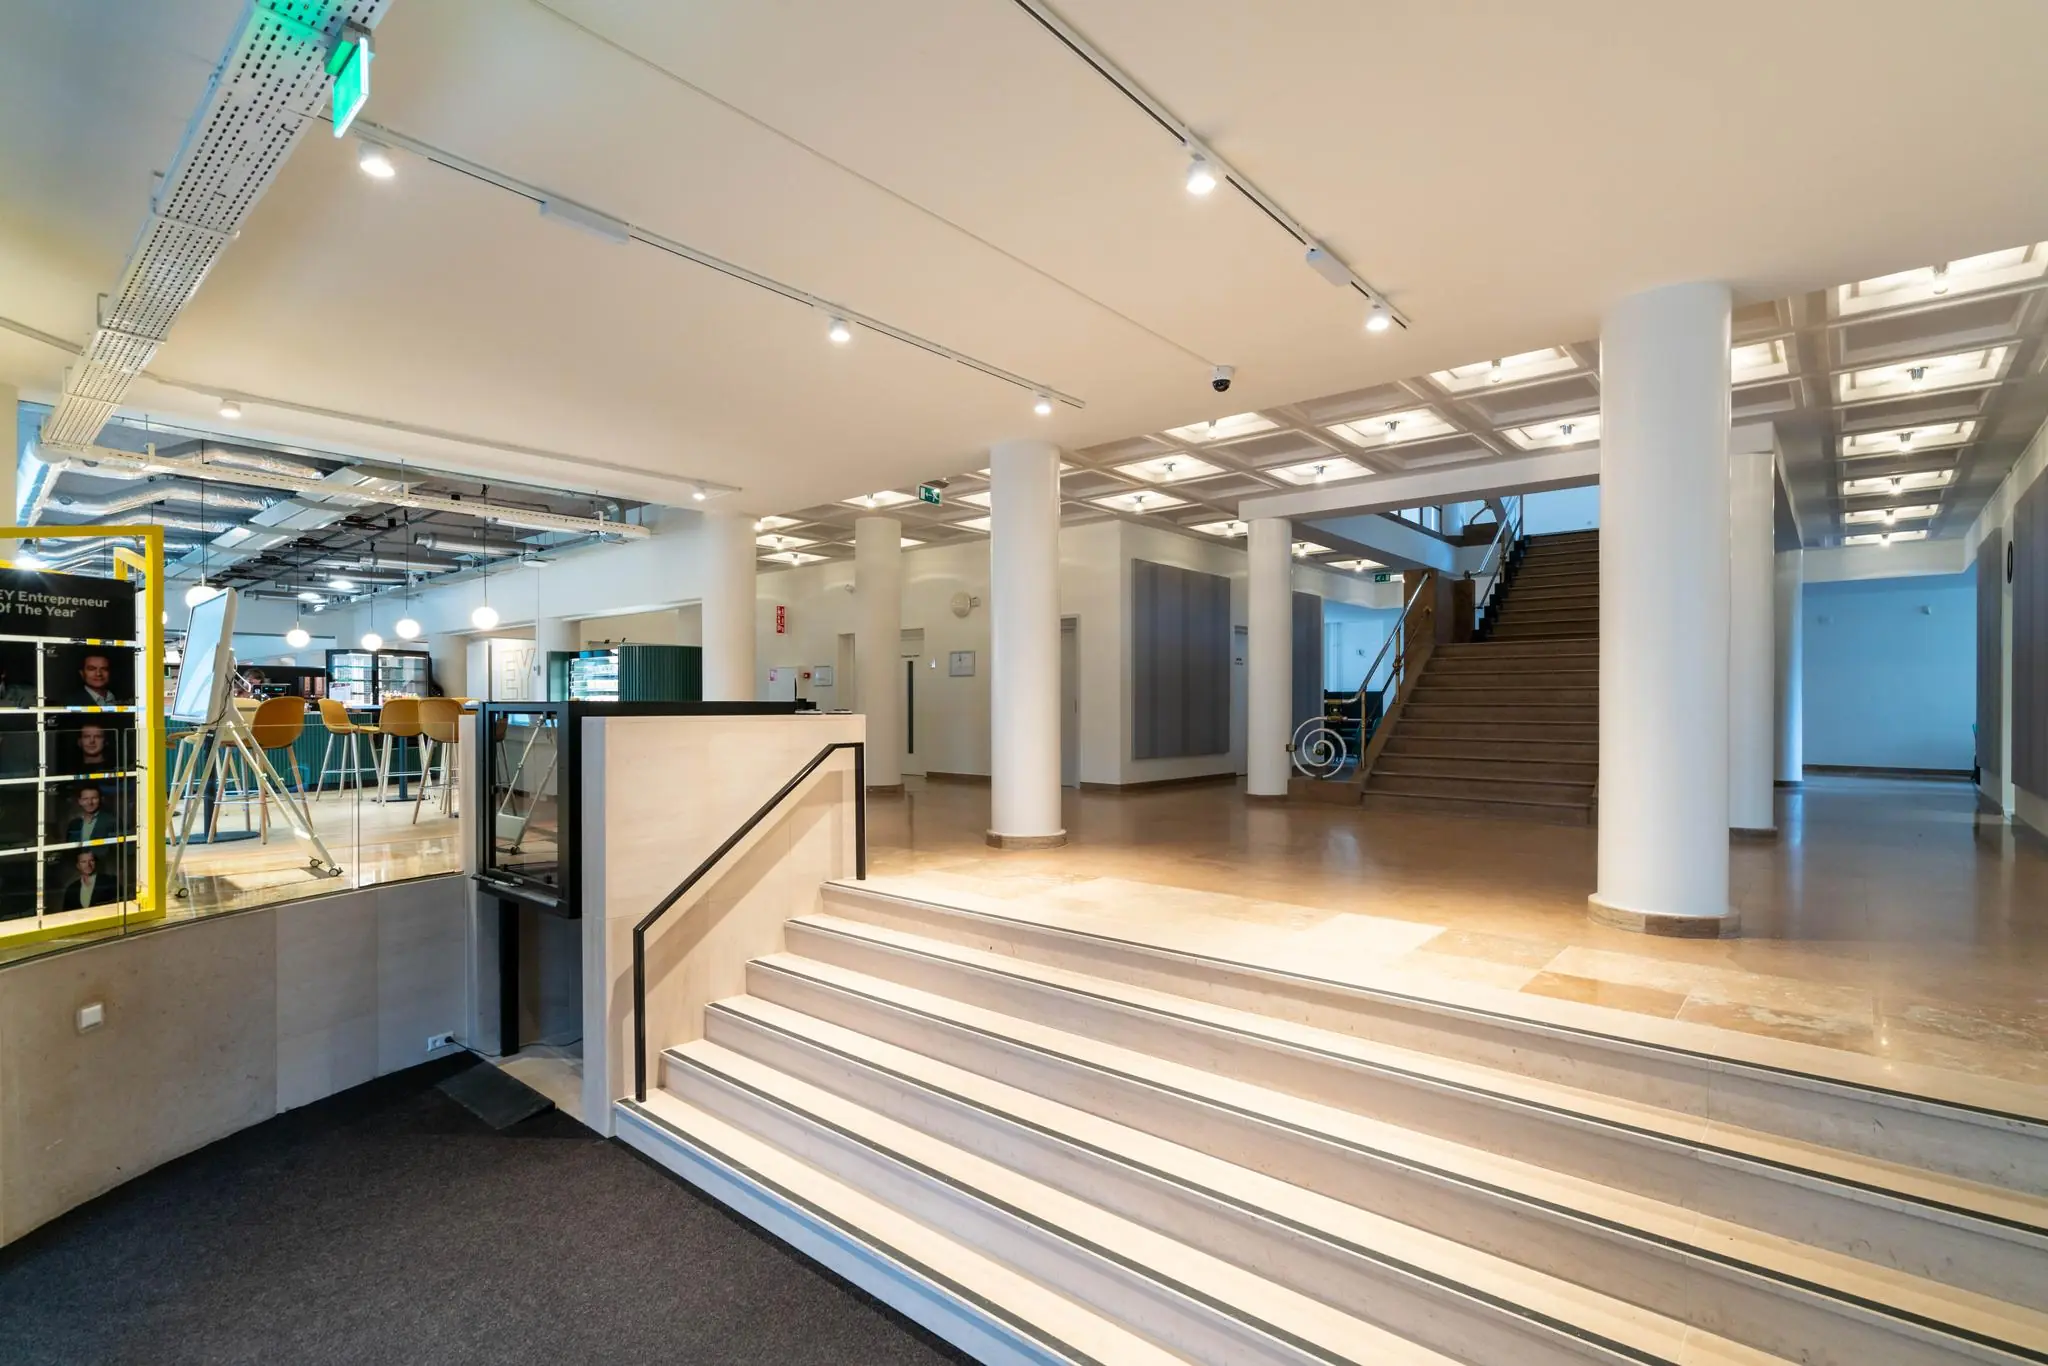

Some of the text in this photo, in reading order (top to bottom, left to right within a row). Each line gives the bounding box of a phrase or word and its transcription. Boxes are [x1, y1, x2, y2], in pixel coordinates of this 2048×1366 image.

[18, 591, 110, 608] Entrepreneur
[15, 604, 42, 616] The
[45, 606, 76, 618] Year
[501, 648, 535, 700] EY
